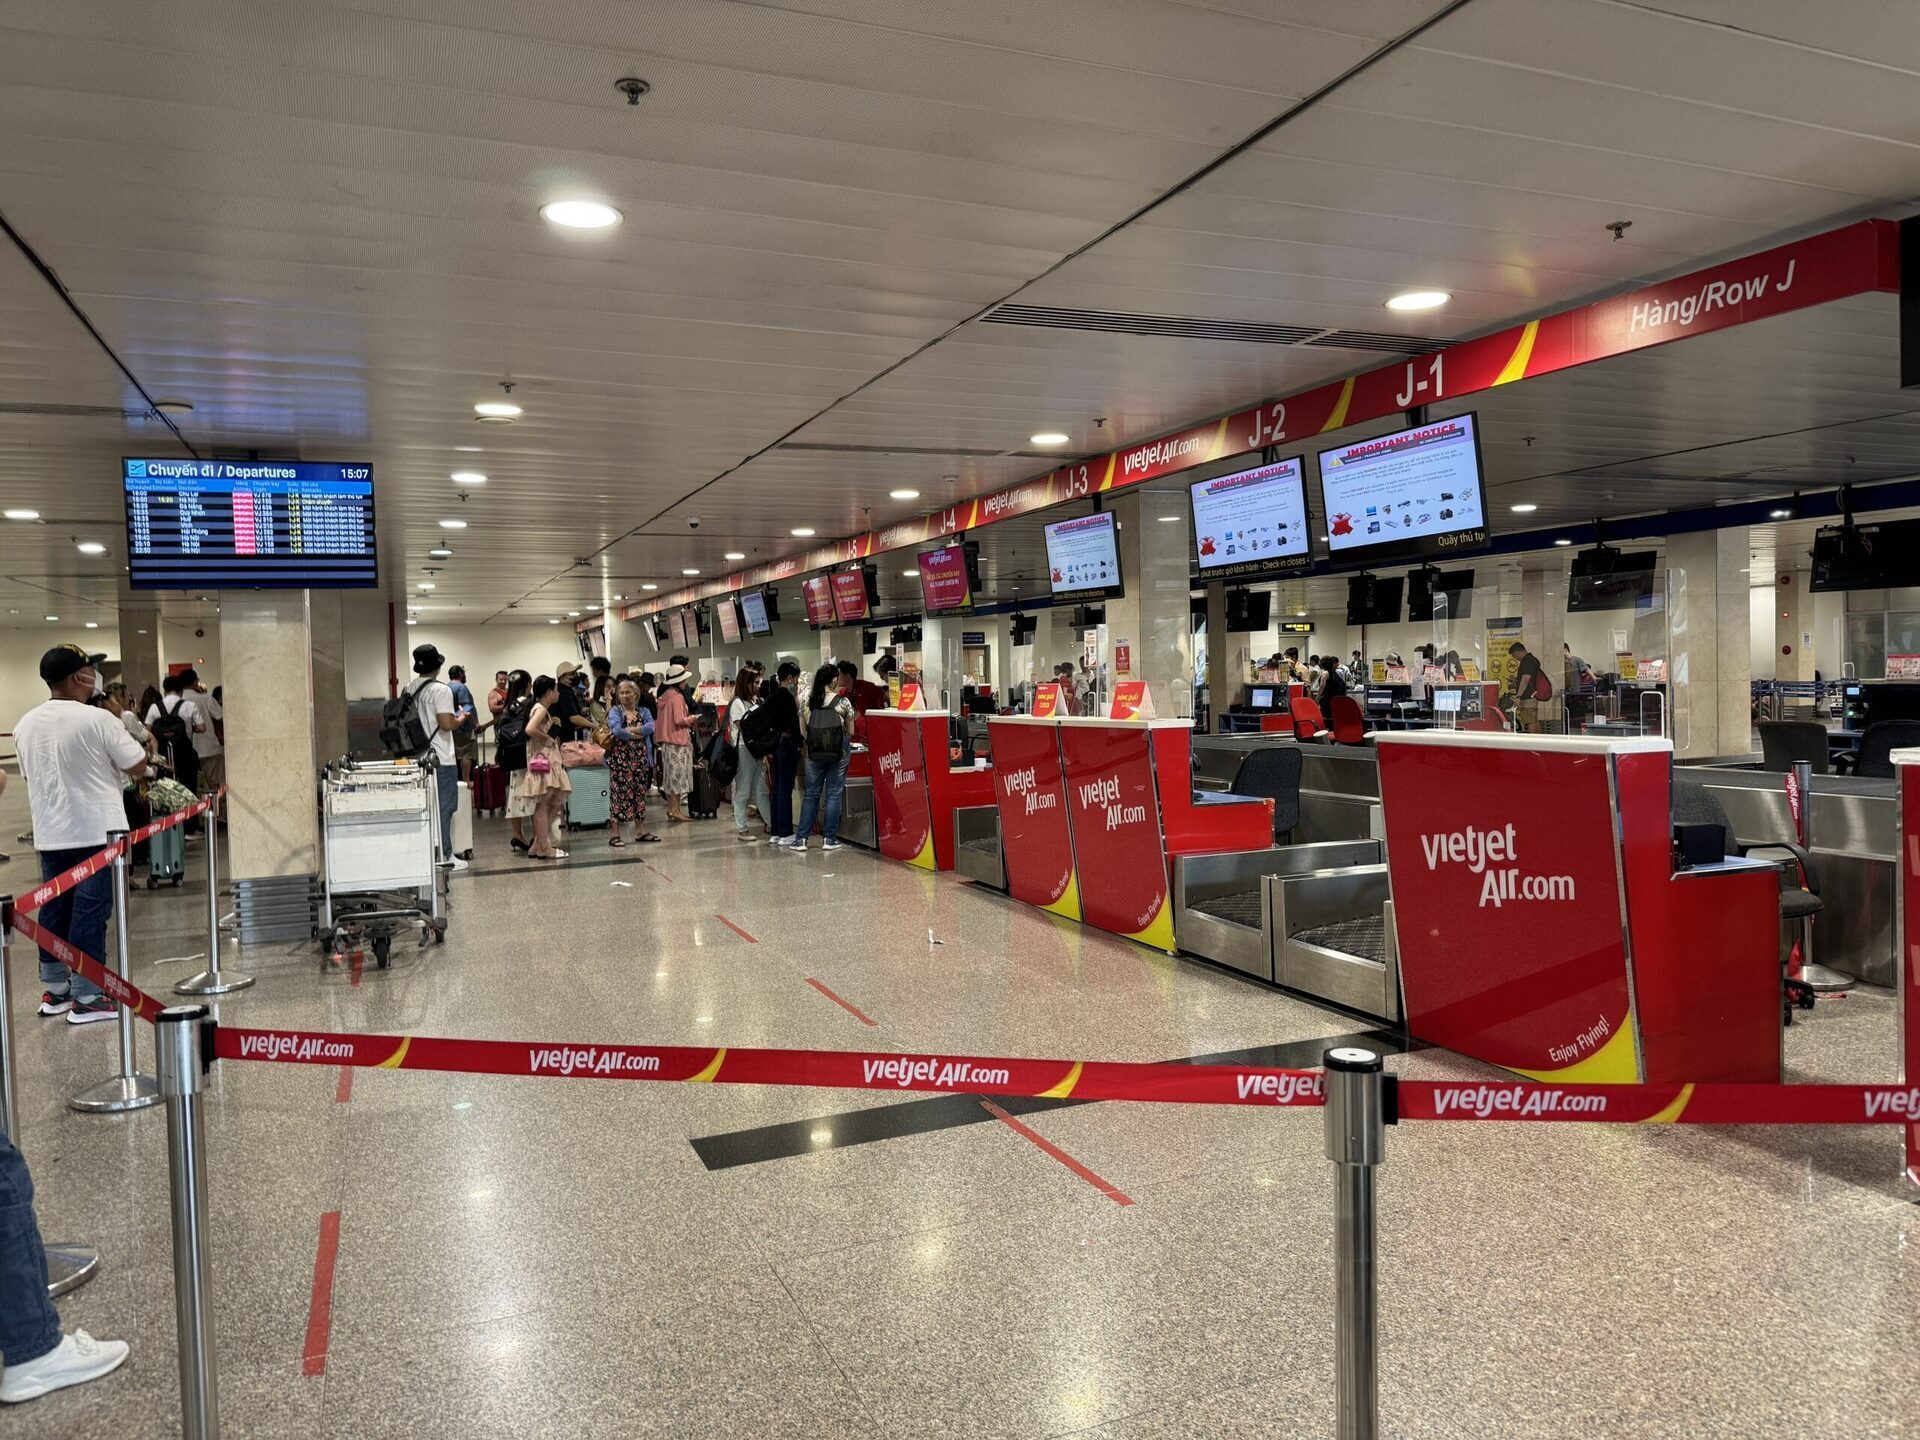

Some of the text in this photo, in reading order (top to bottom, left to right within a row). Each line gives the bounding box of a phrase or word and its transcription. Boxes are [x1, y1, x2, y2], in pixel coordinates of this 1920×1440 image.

[1630, 260, 1796, 332] Hàng/Row J
[1396, 354, 1443, 406] J-1
[1248, 404, 1285, 448] J-2
[1348, 424, 1455, 456] IMPORTANT NOTICE
[149, 464, 296, 478] Chuyến đi / Departures
[341, 469, 368, 478] 15:07
[1066, 466, 1088, 498] J-3
[1211, 465, 1288, 489] IMPORTANT NOTICE
[941, 508, 955, 533] J-4
[1460, 531, 1473, 542] thủ
[846, 540, 856, 559] J-5
[1262, 560, 1286, 570] Check-in
[1287, 557, 1305, 566] closes
[1549, 1014, 1609, 1062] Enjoy Flying!
